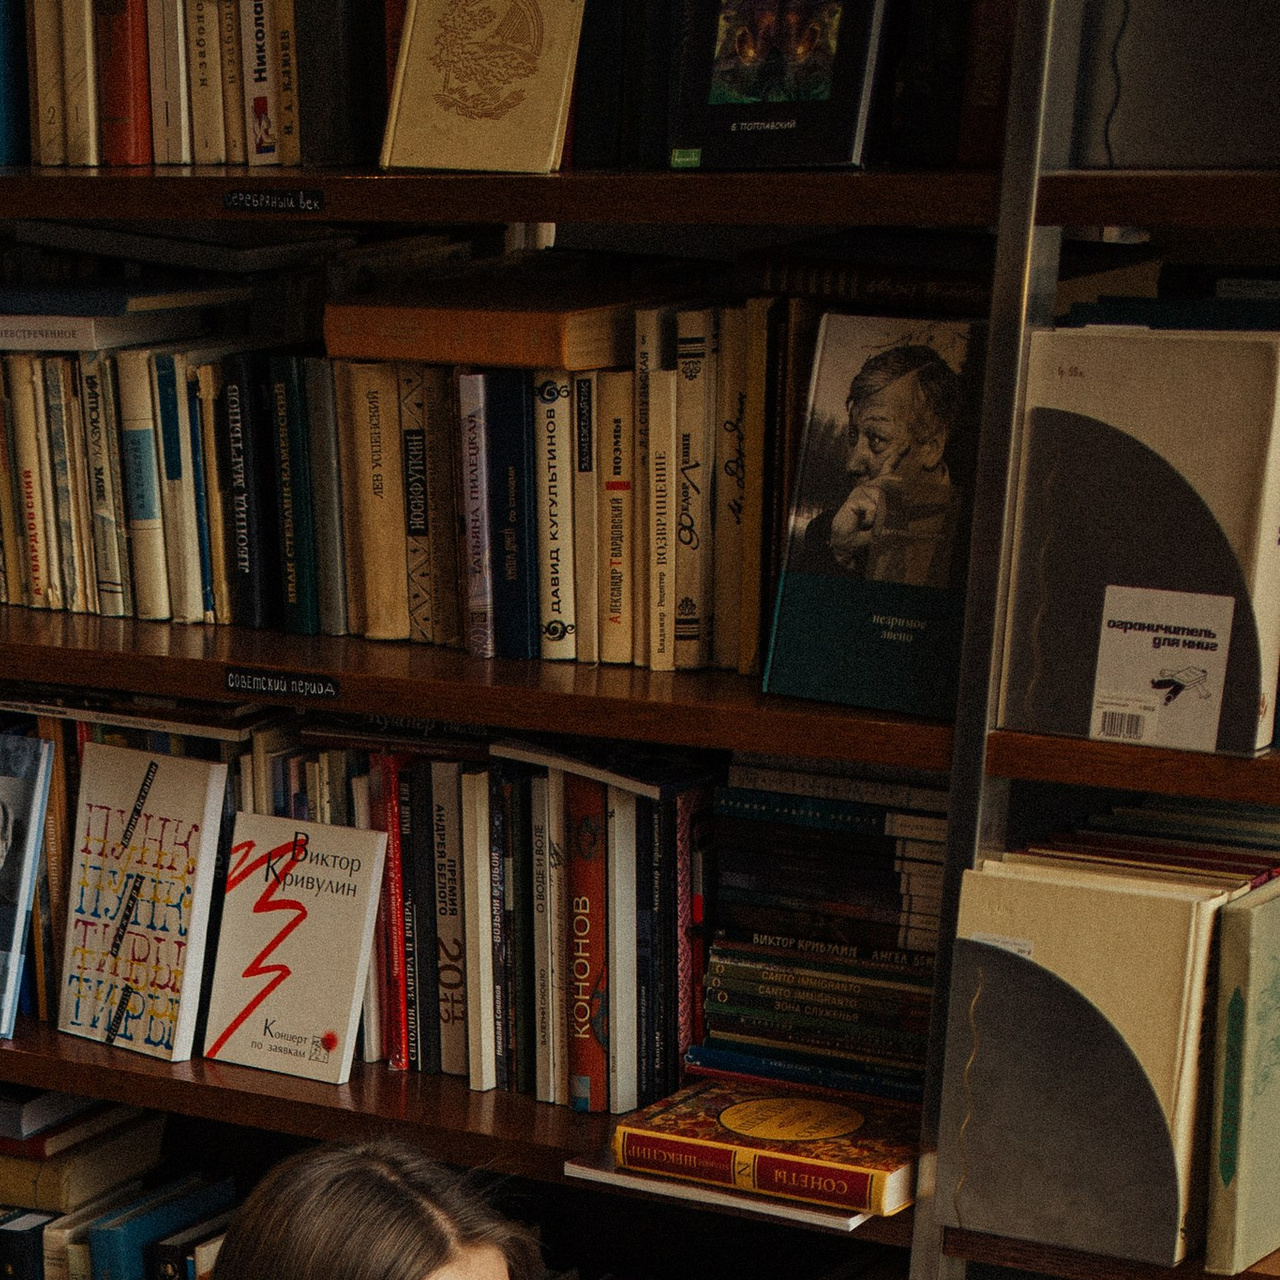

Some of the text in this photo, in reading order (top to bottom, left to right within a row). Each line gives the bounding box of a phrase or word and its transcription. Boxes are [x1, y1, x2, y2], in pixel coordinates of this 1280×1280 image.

[227, 384, 250, 574] ЛЕОНИД МАРТЫНОВ
[547, 409, 561, 614] ДАВИД КУГУЛЬТИНОВ
[657, 451, 668, 566] ВОЗВРАЩЕНИЕ
[293, 831, 362, 873] Виктор
[436, 805, 447, 917] АНДРЕЯ БЕЛОГО
[533, 824, 543, 855] ВОЛЕ
[265, 851, 359, 899] Кривулин
[449, 860, 458, 917] ПРЕМИЯ
[535, 869, 546, 900] ВОДЕ
[752, 931, 797, 950] ВИКТОР
[573, 894, 591, 1039] КОНОНОВ
[263, 1018, 308, 1047] Концерт
[774, 1168, 849, 1195] СОНЕТЫ
